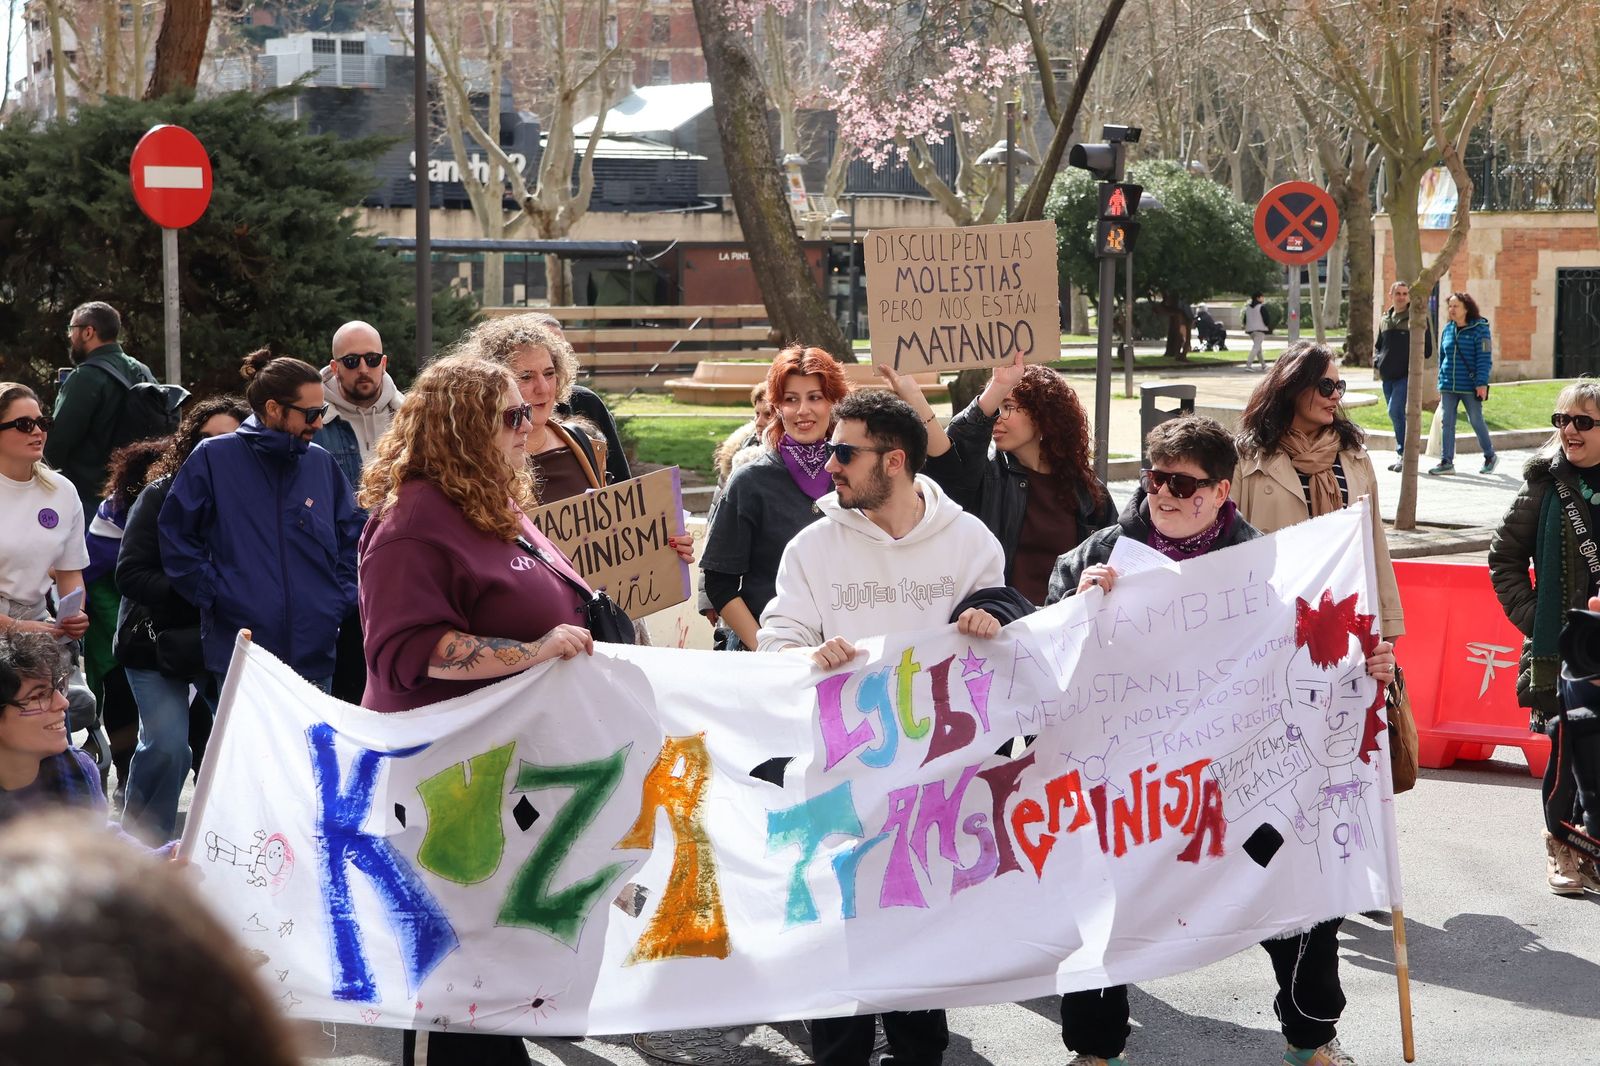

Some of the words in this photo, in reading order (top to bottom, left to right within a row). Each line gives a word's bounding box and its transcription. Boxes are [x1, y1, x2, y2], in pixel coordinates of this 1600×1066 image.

[876, 231, 988, 263] DISCULPEN
[999, 232, 1033, 260] LAS
[895, 262, 1022, 293] MOLESTIAS
[879, 298, 923, 323] PERO
[939, 296, 971, 320] NOS
[982, 289, 1037, 317] ESTÁN
[894, 319, 1034, 371] MATANDO
[1564, 501, 1587, 535] BIMBA
[1008, 639, 1049, 699] A
[1137, 716, 1225, 758] TRANS
